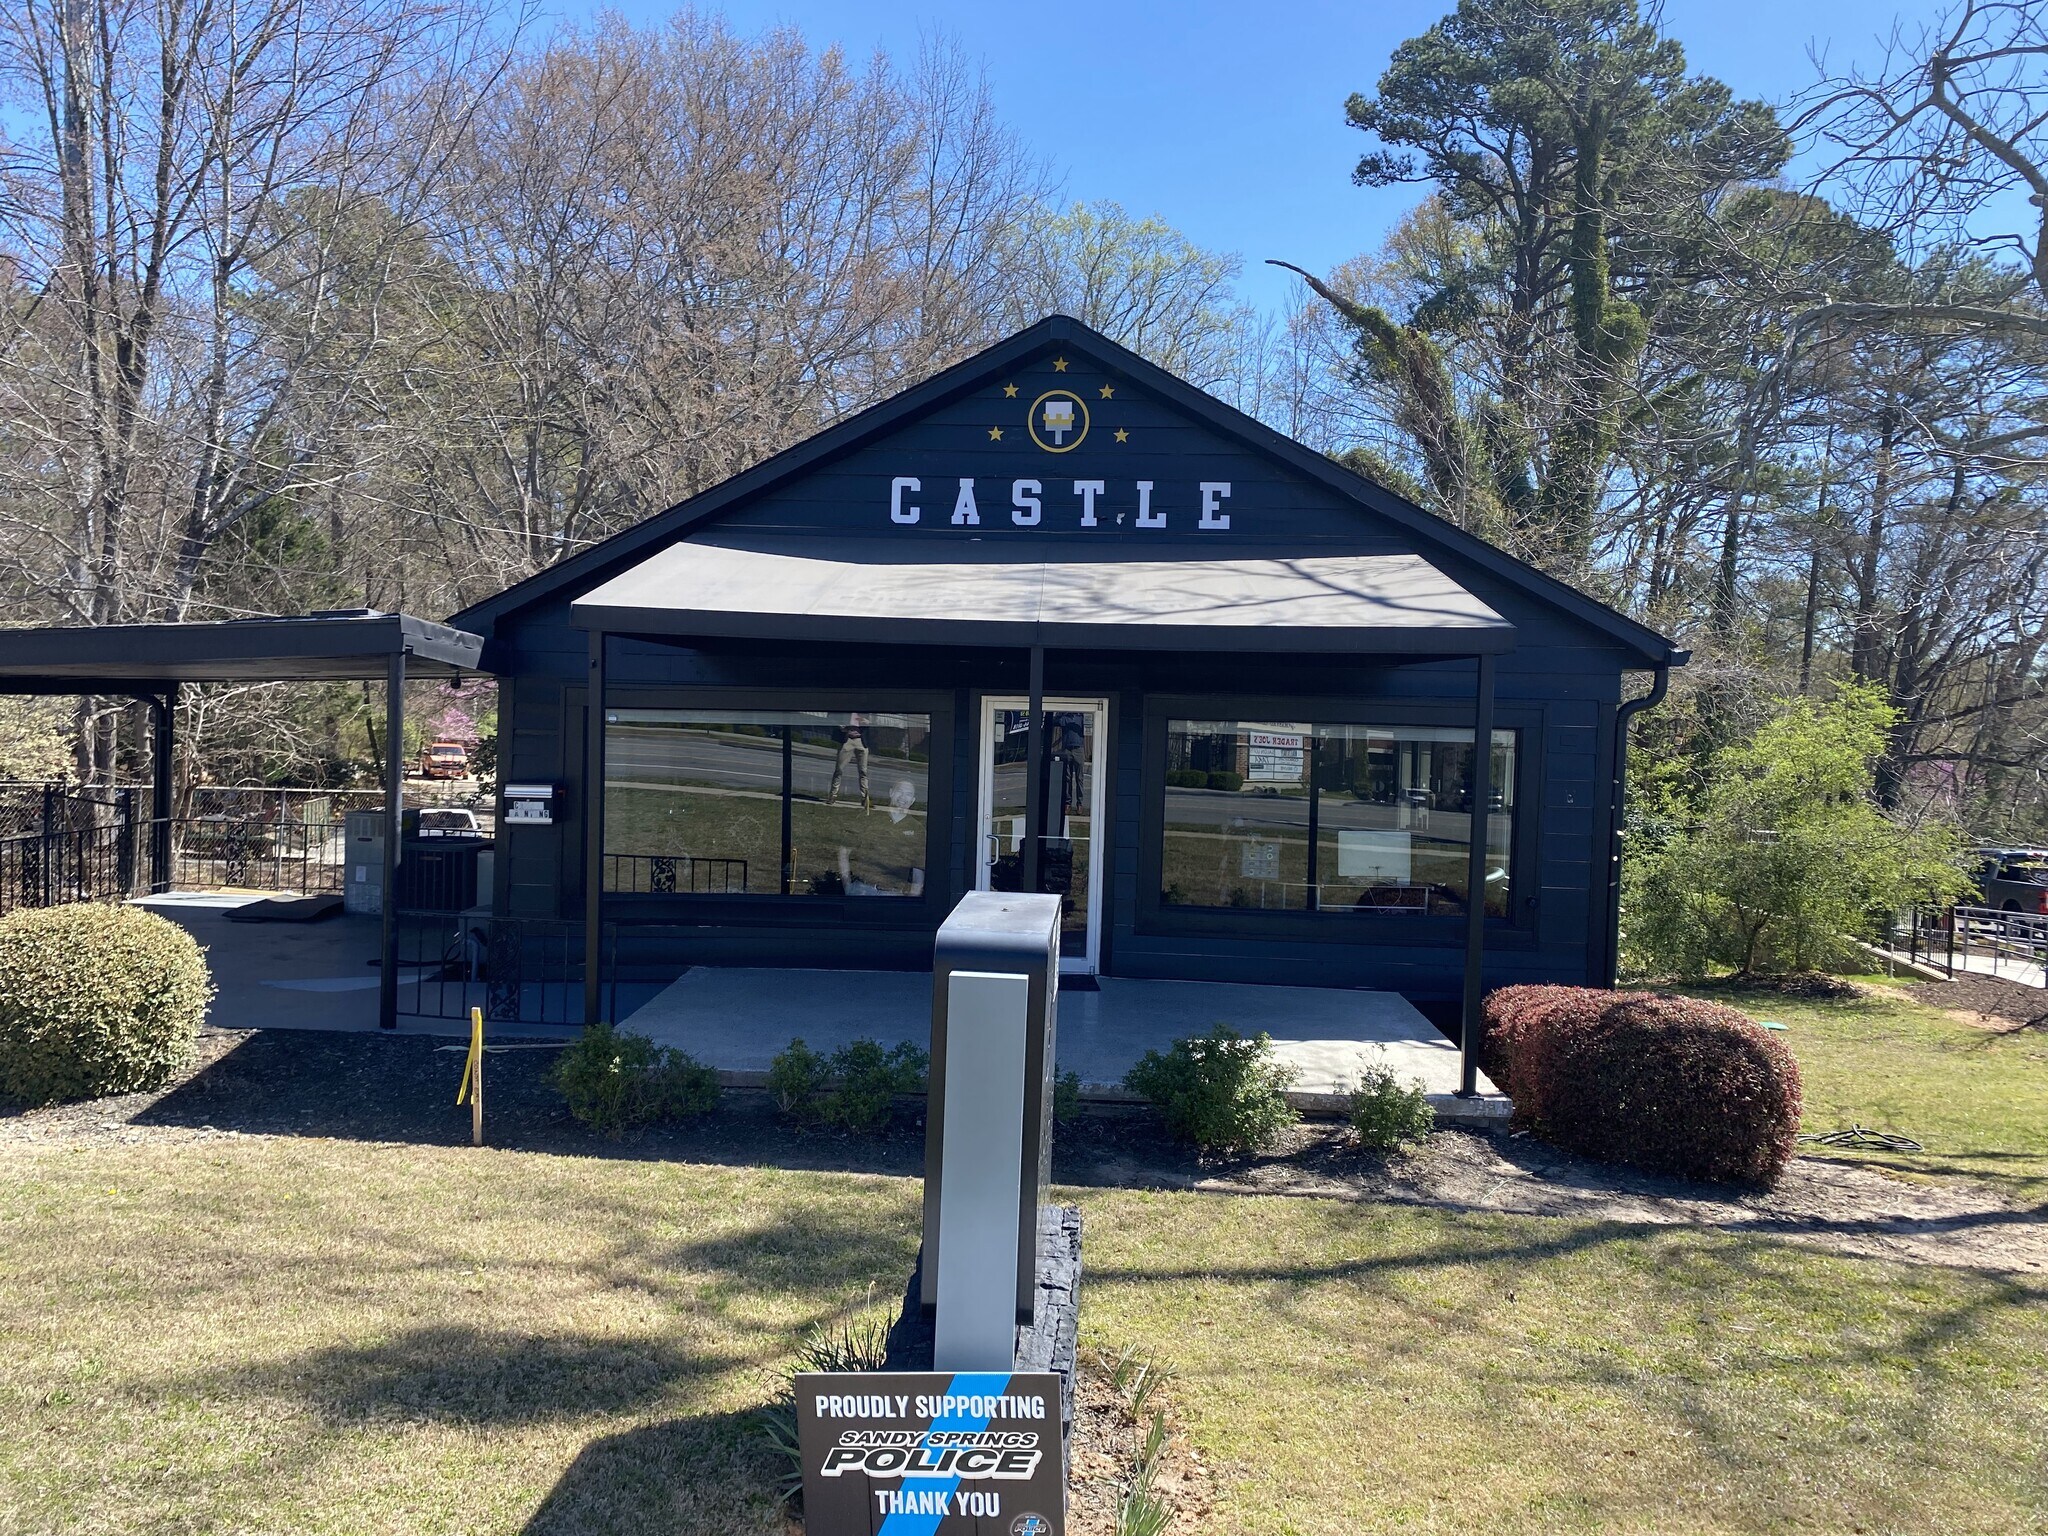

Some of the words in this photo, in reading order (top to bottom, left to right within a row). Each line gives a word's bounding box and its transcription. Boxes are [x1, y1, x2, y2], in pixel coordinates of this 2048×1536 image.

[890, 476, 1232, 530] CASTLE
[815, 1395, 909, 1419] PROUDLY
[915, 1395, 1046, 1420] SUPPORTING
[839, 1430, 927, 1447] SANDY
[927, 1431, 1040, 1448] SPRINGS
[820, 1448, 1043, 1480] POLICE
[874, 1490, 951, 1517] THANK
[954, 1491, 1001, 1518] YOU
